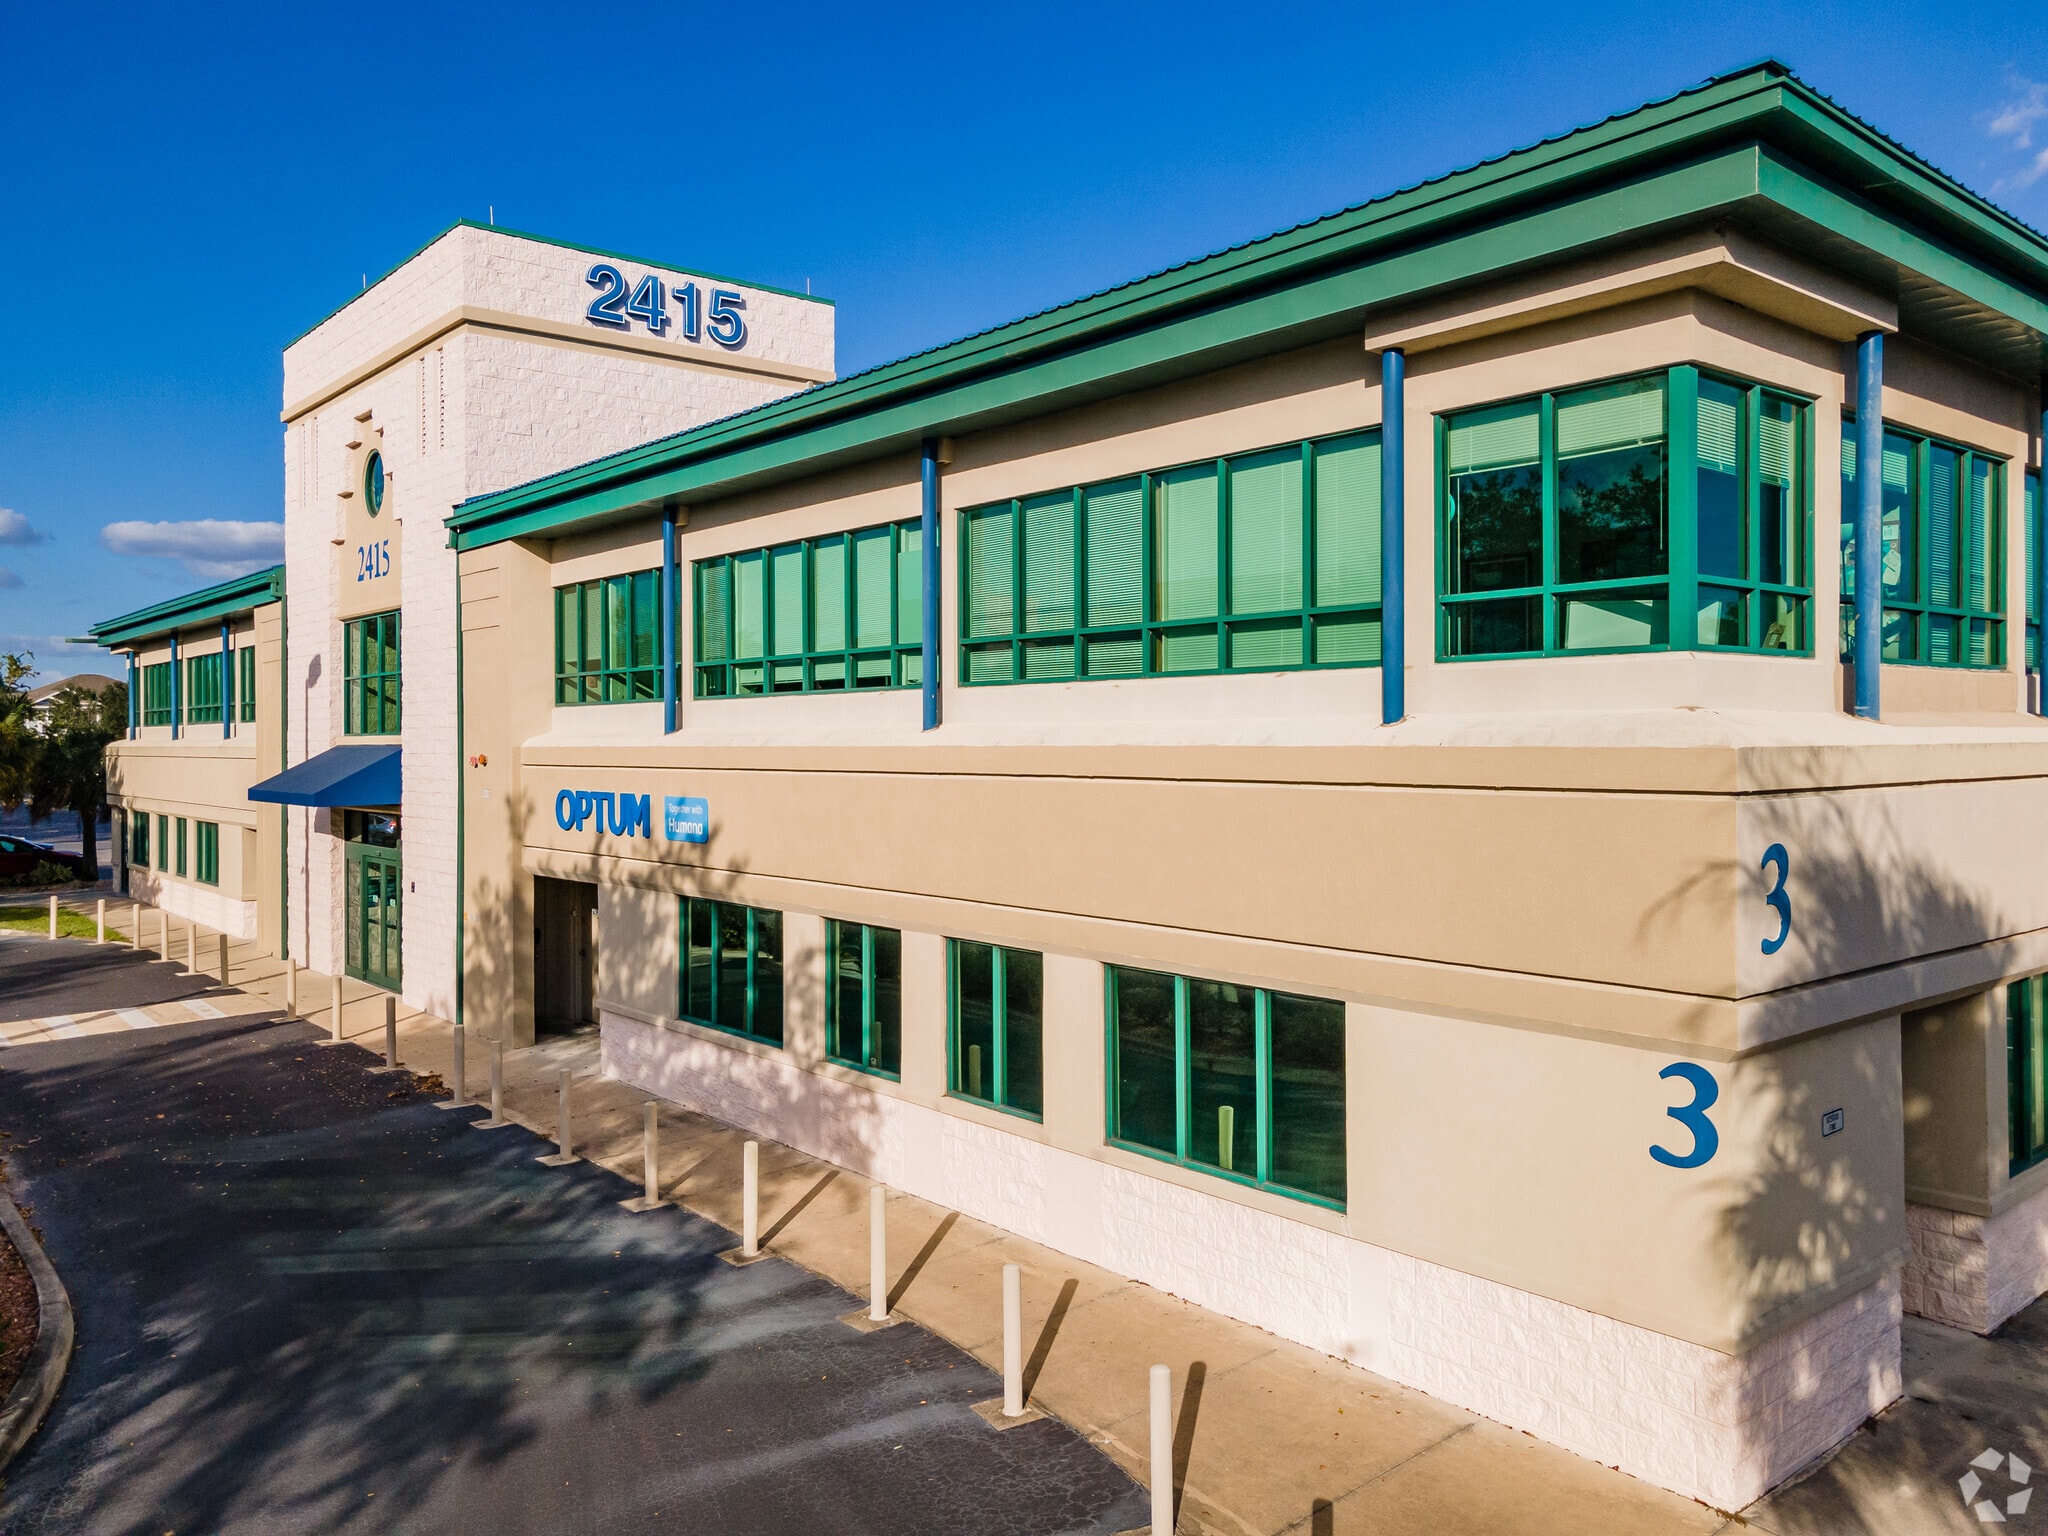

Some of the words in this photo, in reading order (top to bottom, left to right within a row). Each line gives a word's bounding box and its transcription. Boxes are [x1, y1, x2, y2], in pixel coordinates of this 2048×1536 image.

[586, 263, 746, 346] 2415
[357, 539, 390, 582] 2415
[555, 789, 651, 839] OPTUM
[668, 817, 703, 835] Humana
[691, 804, 704, 815] with
[1761, 843, 1791, 955] 3
[1649, 1062, 1719, 1169] 3
